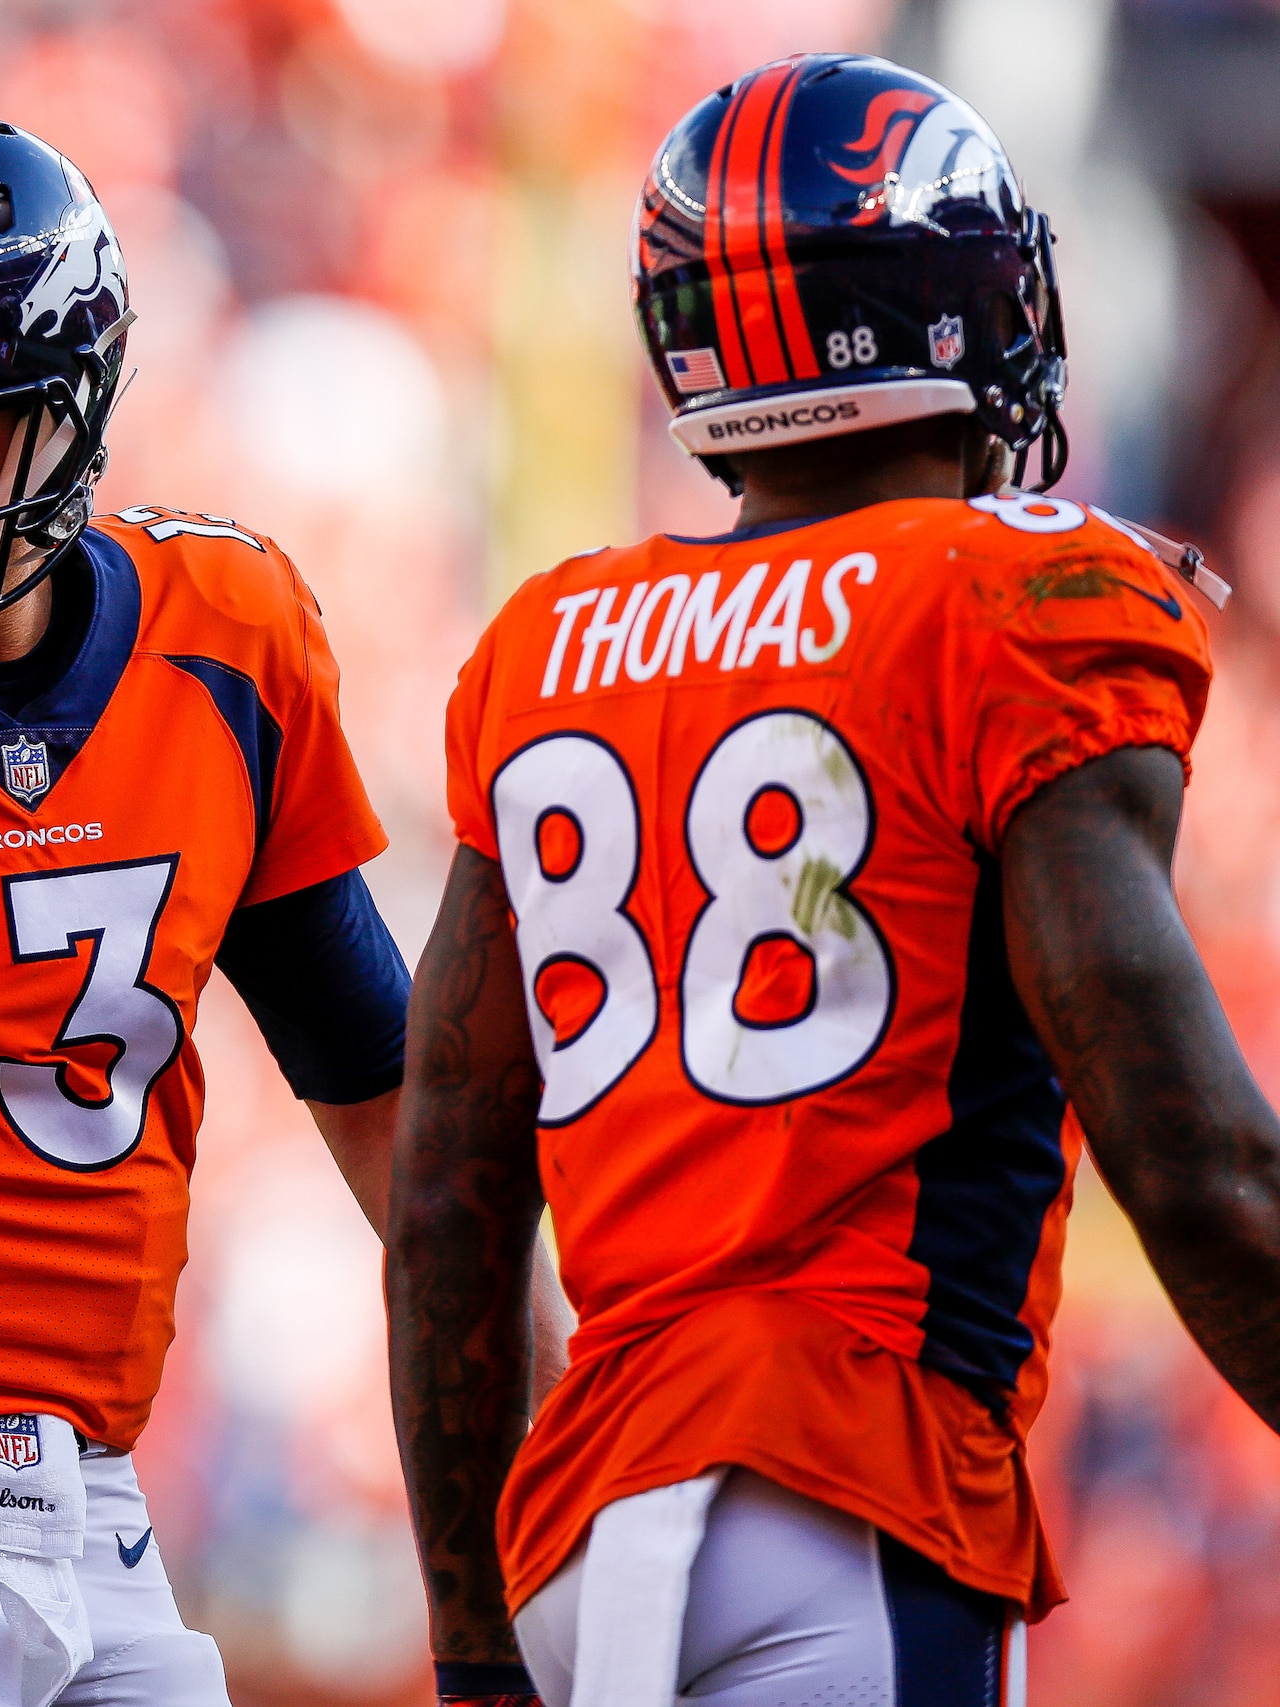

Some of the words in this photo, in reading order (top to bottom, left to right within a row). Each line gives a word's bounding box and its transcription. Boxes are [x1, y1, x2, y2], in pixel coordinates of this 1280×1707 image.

[826, 325, 879, 369] 88
[708, 401, 861, 440] BRONCOS
[539, 551, 878, 699] THOMAS
[11, 765, 44, 789] NFL
[491, 708, 898, 1128] 88
